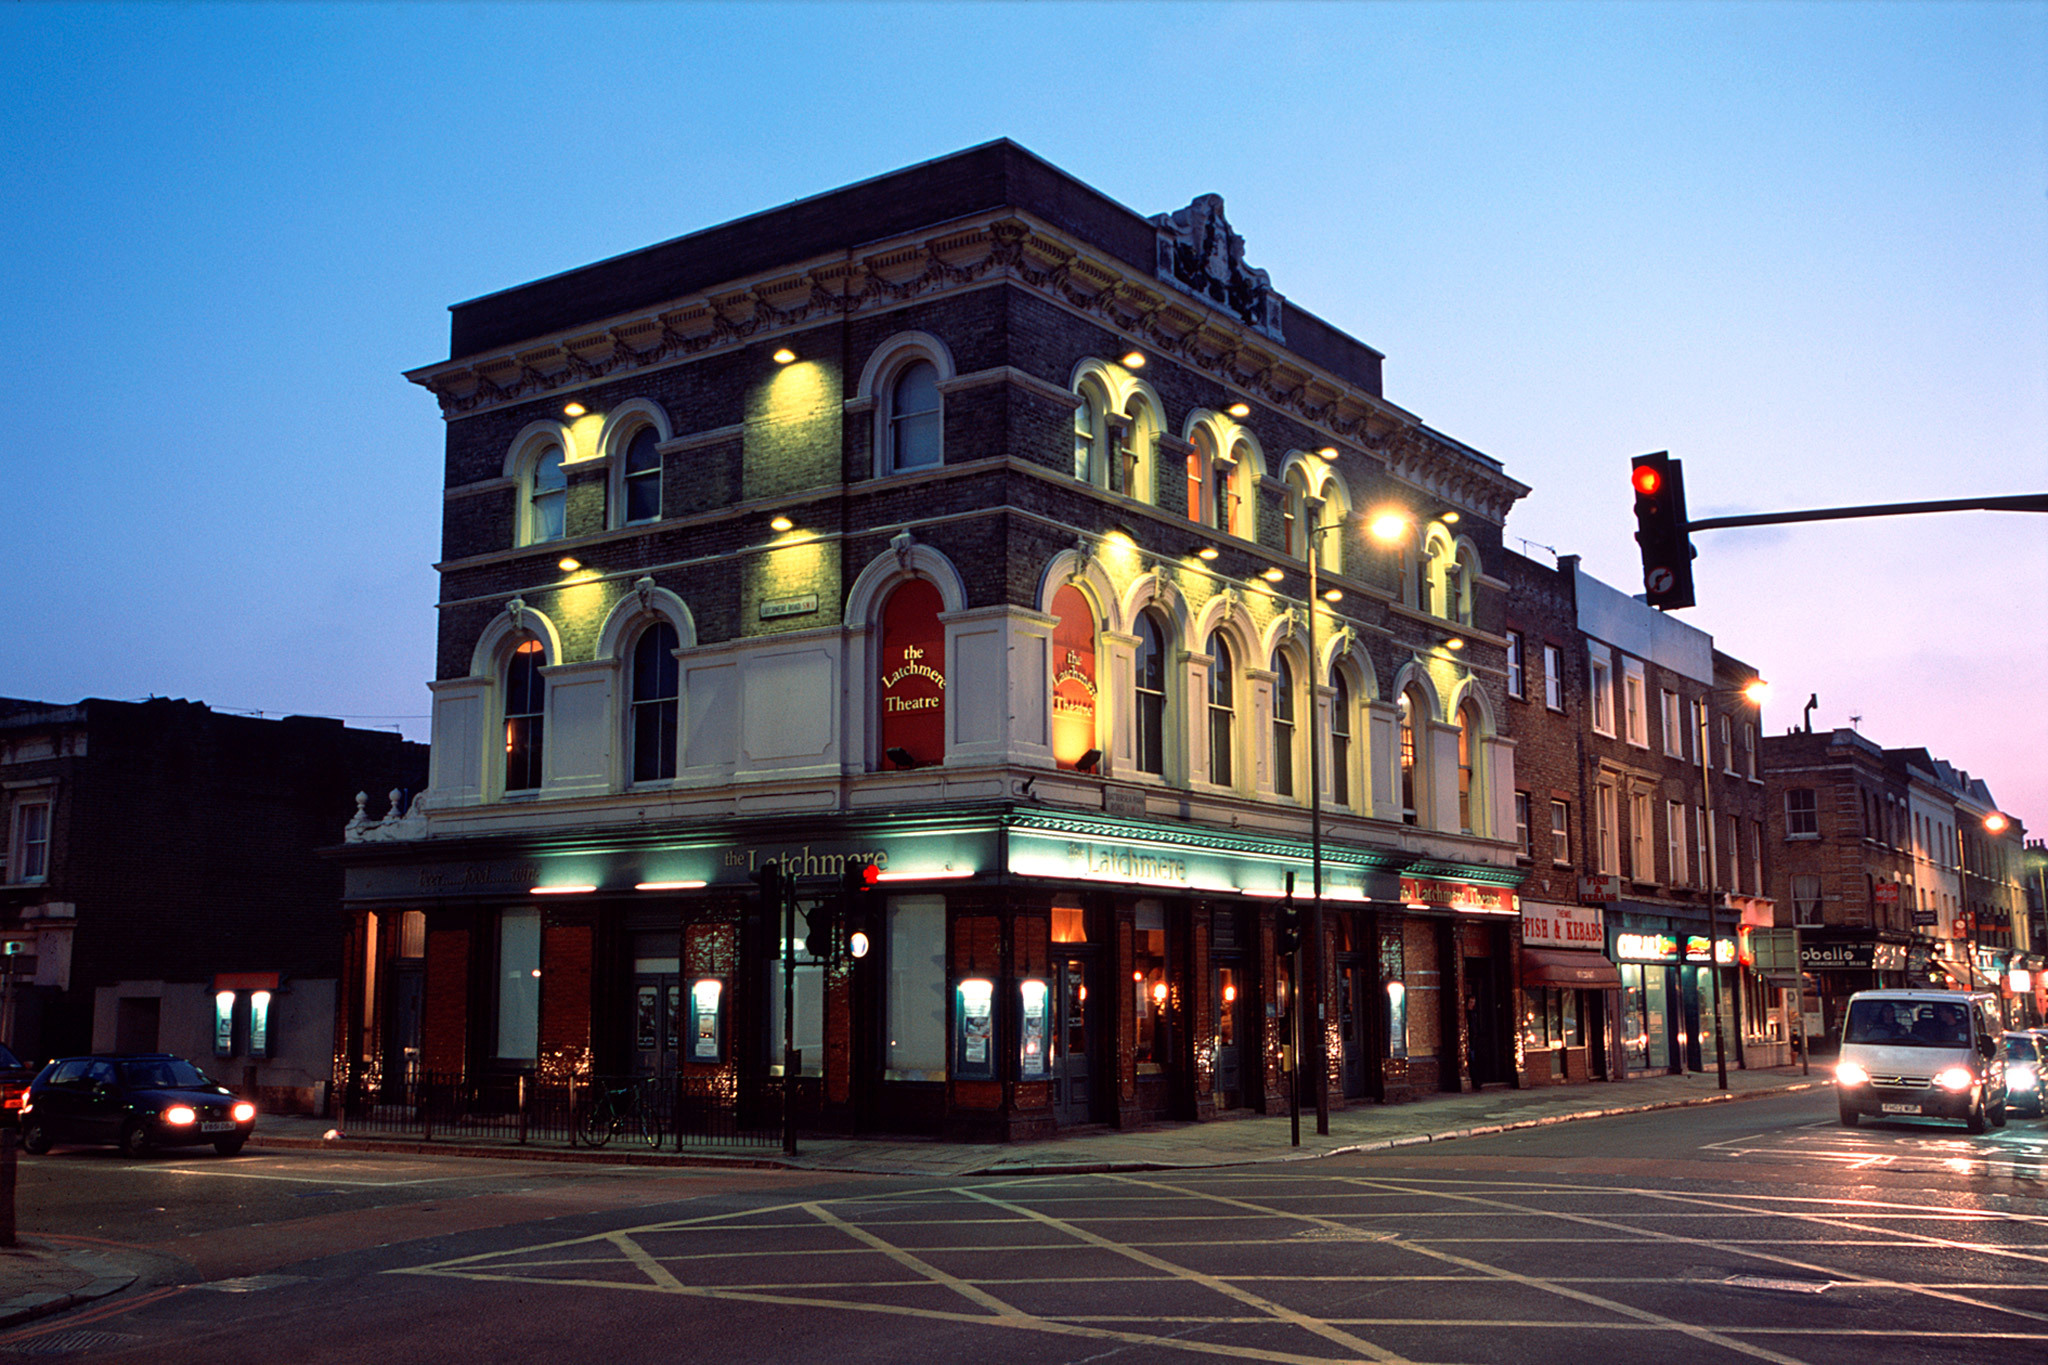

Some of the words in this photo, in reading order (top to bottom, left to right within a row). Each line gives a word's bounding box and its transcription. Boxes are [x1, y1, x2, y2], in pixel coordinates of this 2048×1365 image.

[904, 645, 924, 660] the
[1067, 649, 1083, 666] the
[881, 659, 947, 690] Latchmere
[885, 696, 940, 712] Theatre
[725, 850, 744, 866] the
[1087, 843, 1186, 882] Latchmere
[1586, 876, 1610, 886] FISH
[1414, 881, 1465, 905] Latchmere
[1465, 887, 1502, 906] Theatre
[1581, 893, 1617, 902] KEBABS
[1595, 885, 1603, 894] &
[1524, 917, 1549, 939] FISH
[1554, 919, 1562, 940] &
[1566, 920, 1604, 942] KEBABS
